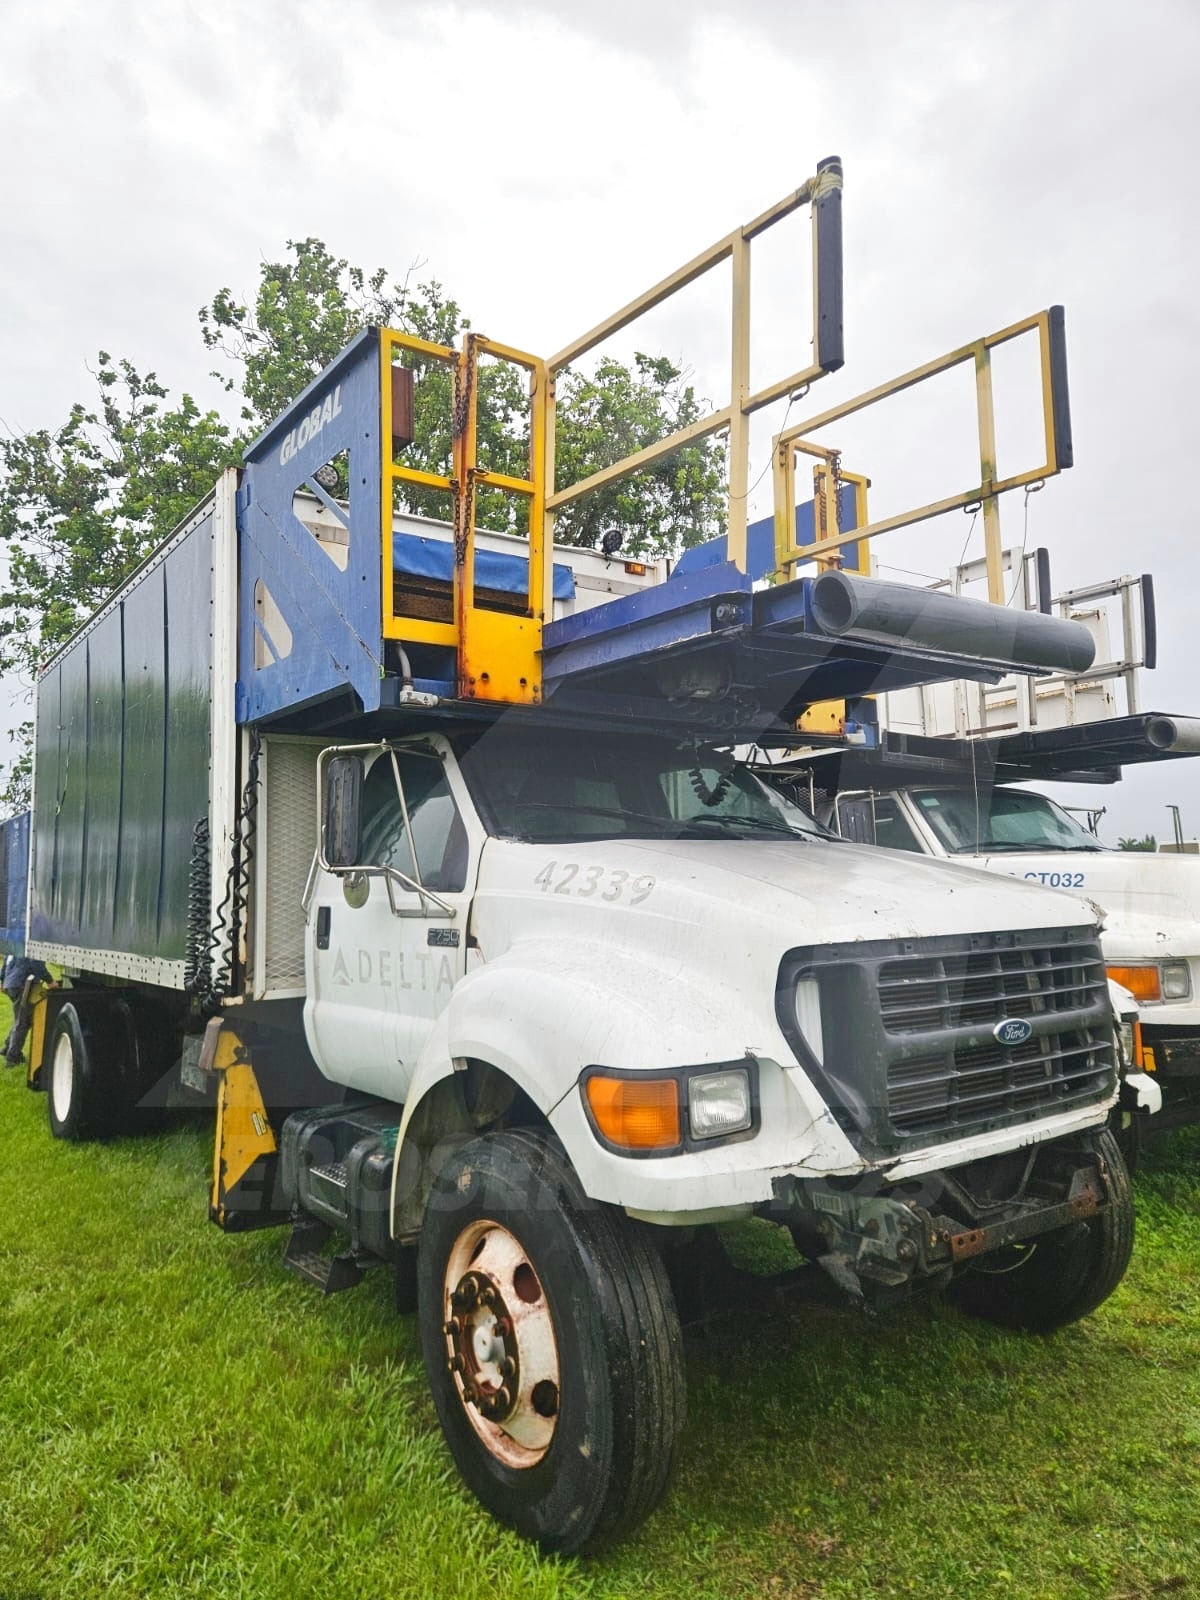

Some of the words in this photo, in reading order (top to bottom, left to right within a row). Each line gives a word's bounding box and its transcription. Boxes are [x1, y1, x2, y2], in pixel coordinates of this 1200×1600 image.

[279, 384, 342, 466] GLOBAL
[534, 860, 656, 905] 42339
[358, 948, 455, 994] DELTA
[1004, 1023, 1026, 1041] Ford
